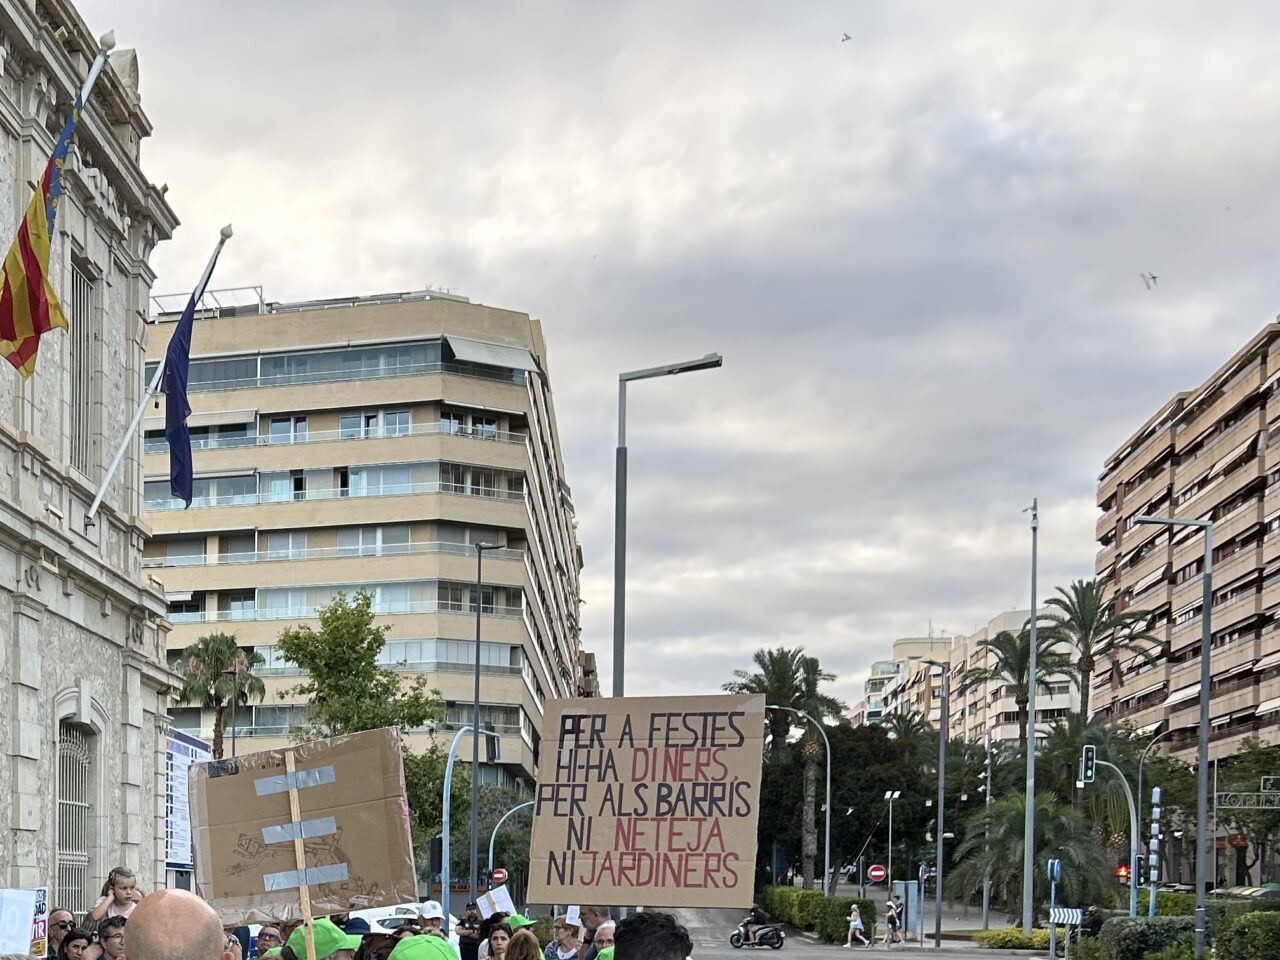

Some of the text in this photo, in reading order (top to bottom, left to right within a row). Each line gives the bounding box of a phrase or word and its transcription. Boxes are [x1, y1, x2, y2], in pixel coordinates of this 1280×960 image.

[558, 711, 745, 749] PER A FESTES
[555, 748, 618, 783] HI-HA
[535, 783, 587, 817] PER
[598, 783, 649, 817] ALS
[567, 816, 725, 852] NI NETEJA
[546, 850, 740, 888] NI JARDINERS
